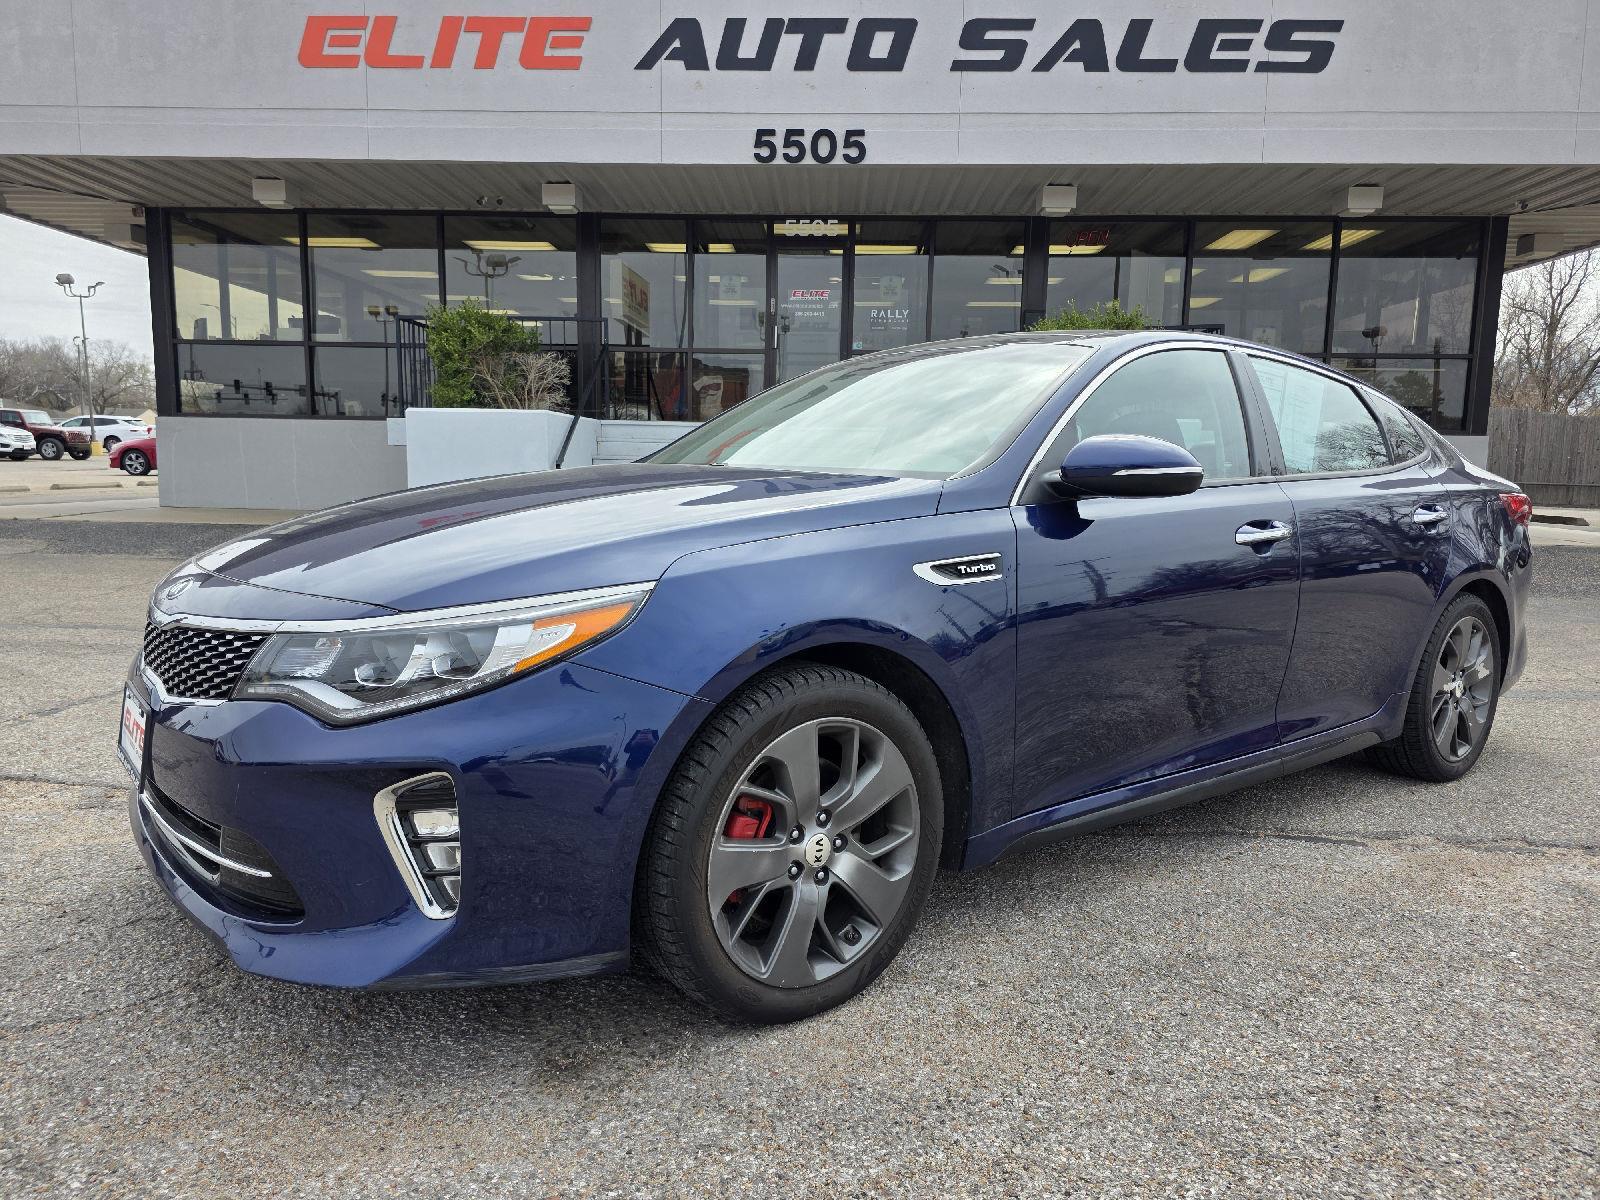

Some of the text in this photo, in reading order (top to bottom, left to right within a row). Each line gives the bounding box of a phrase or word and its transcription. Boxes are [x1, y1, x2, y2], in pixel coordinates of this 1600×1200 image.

[298, 15, 1344, 73] ELITE AUTO SALES
[753, 128, 867, 165] 5505
[791, 289, 831, 298] ELITE
[871, 309, 909, 318] RALLY
[957, 563, 996, 574] Turbo
[814, 837, 824, 864] KIA
